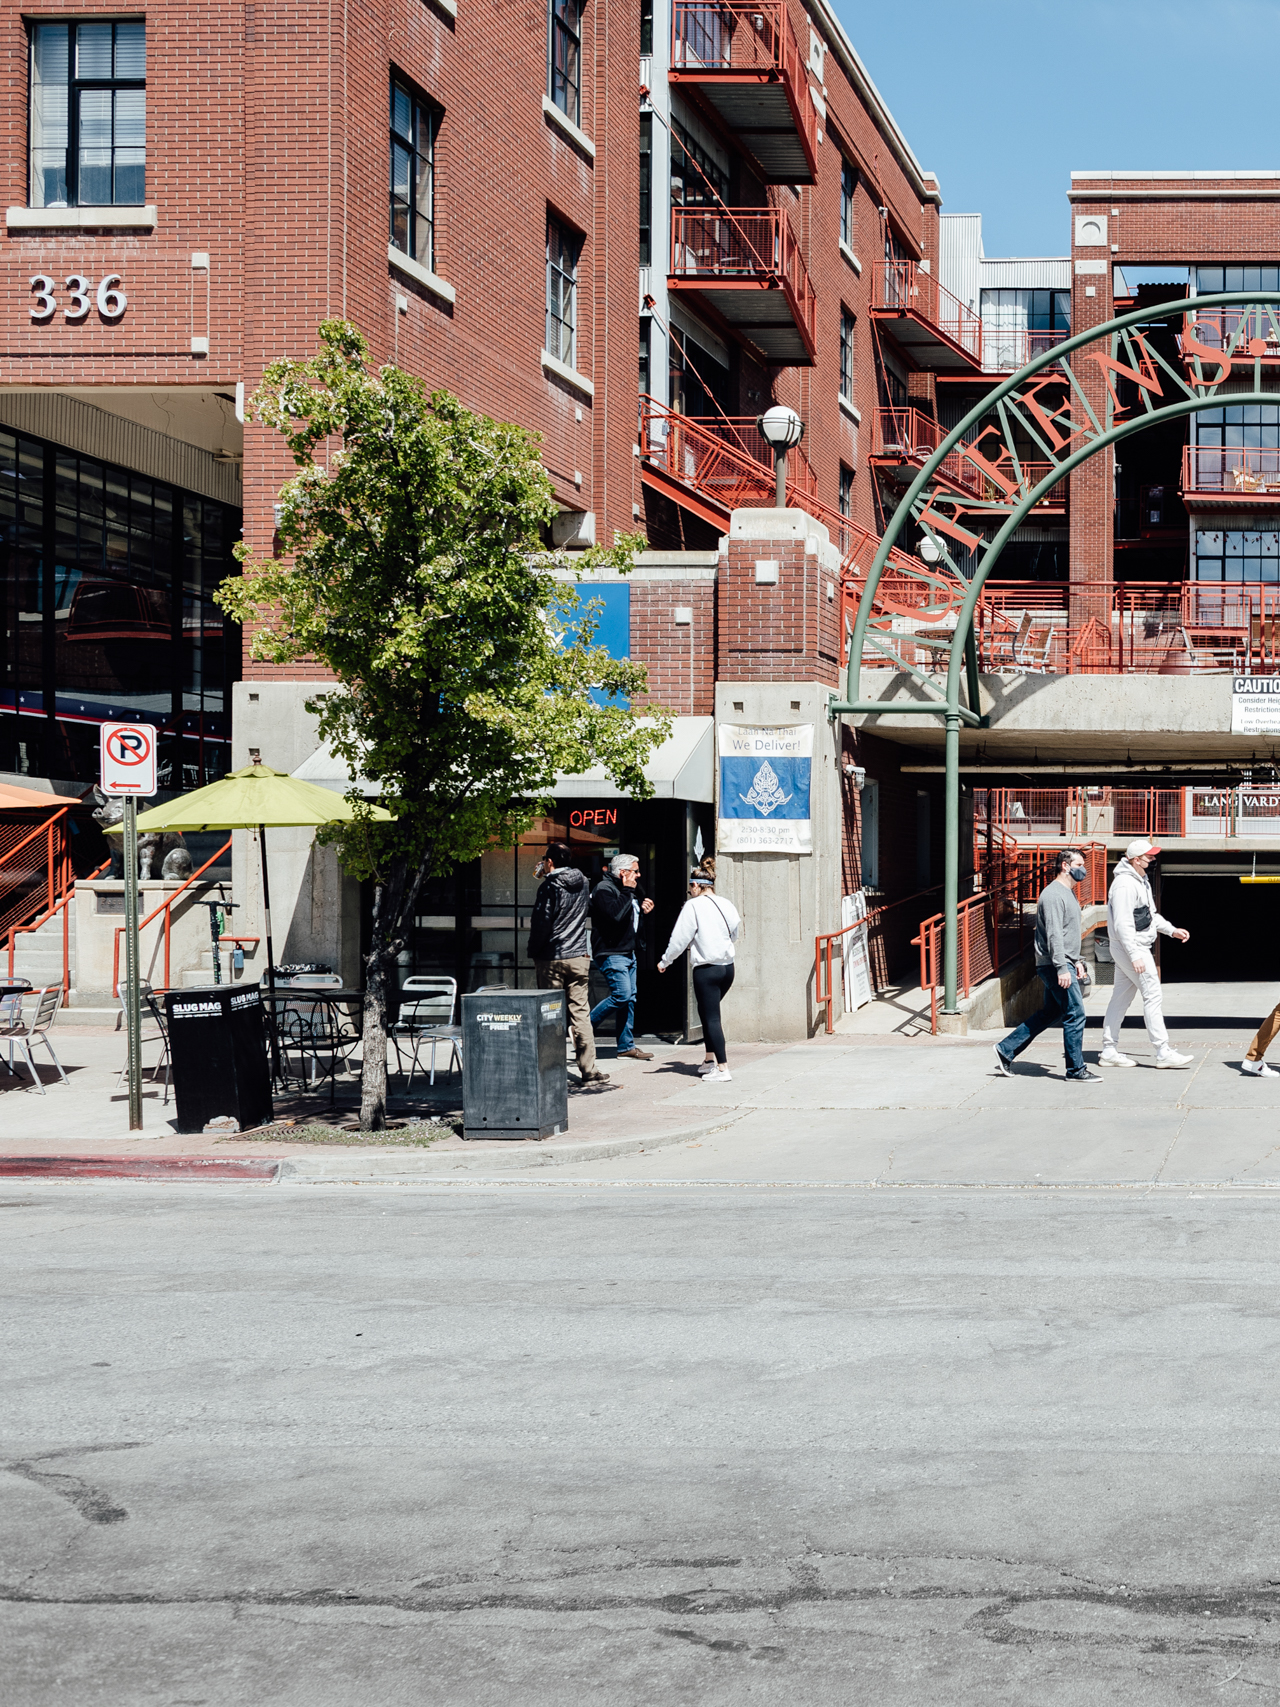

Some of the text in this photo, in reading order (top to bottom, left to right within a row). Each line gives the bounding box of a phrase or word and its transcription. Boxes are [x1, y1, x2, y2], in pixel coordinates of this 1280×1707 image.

[28, 274, 128, 318] 336
[778, 727, 797, 736] Thai
[732, 740, 801, 750] We Deliver!
[570, 808, 617, 827] OPEN
[736, 837, 756, 845] (801)
[231, 991, 259, 1005] SLUG MAG
[172, 1003, 198, 1013] SLUG
[199, 1002, 222, 1011] MAG
